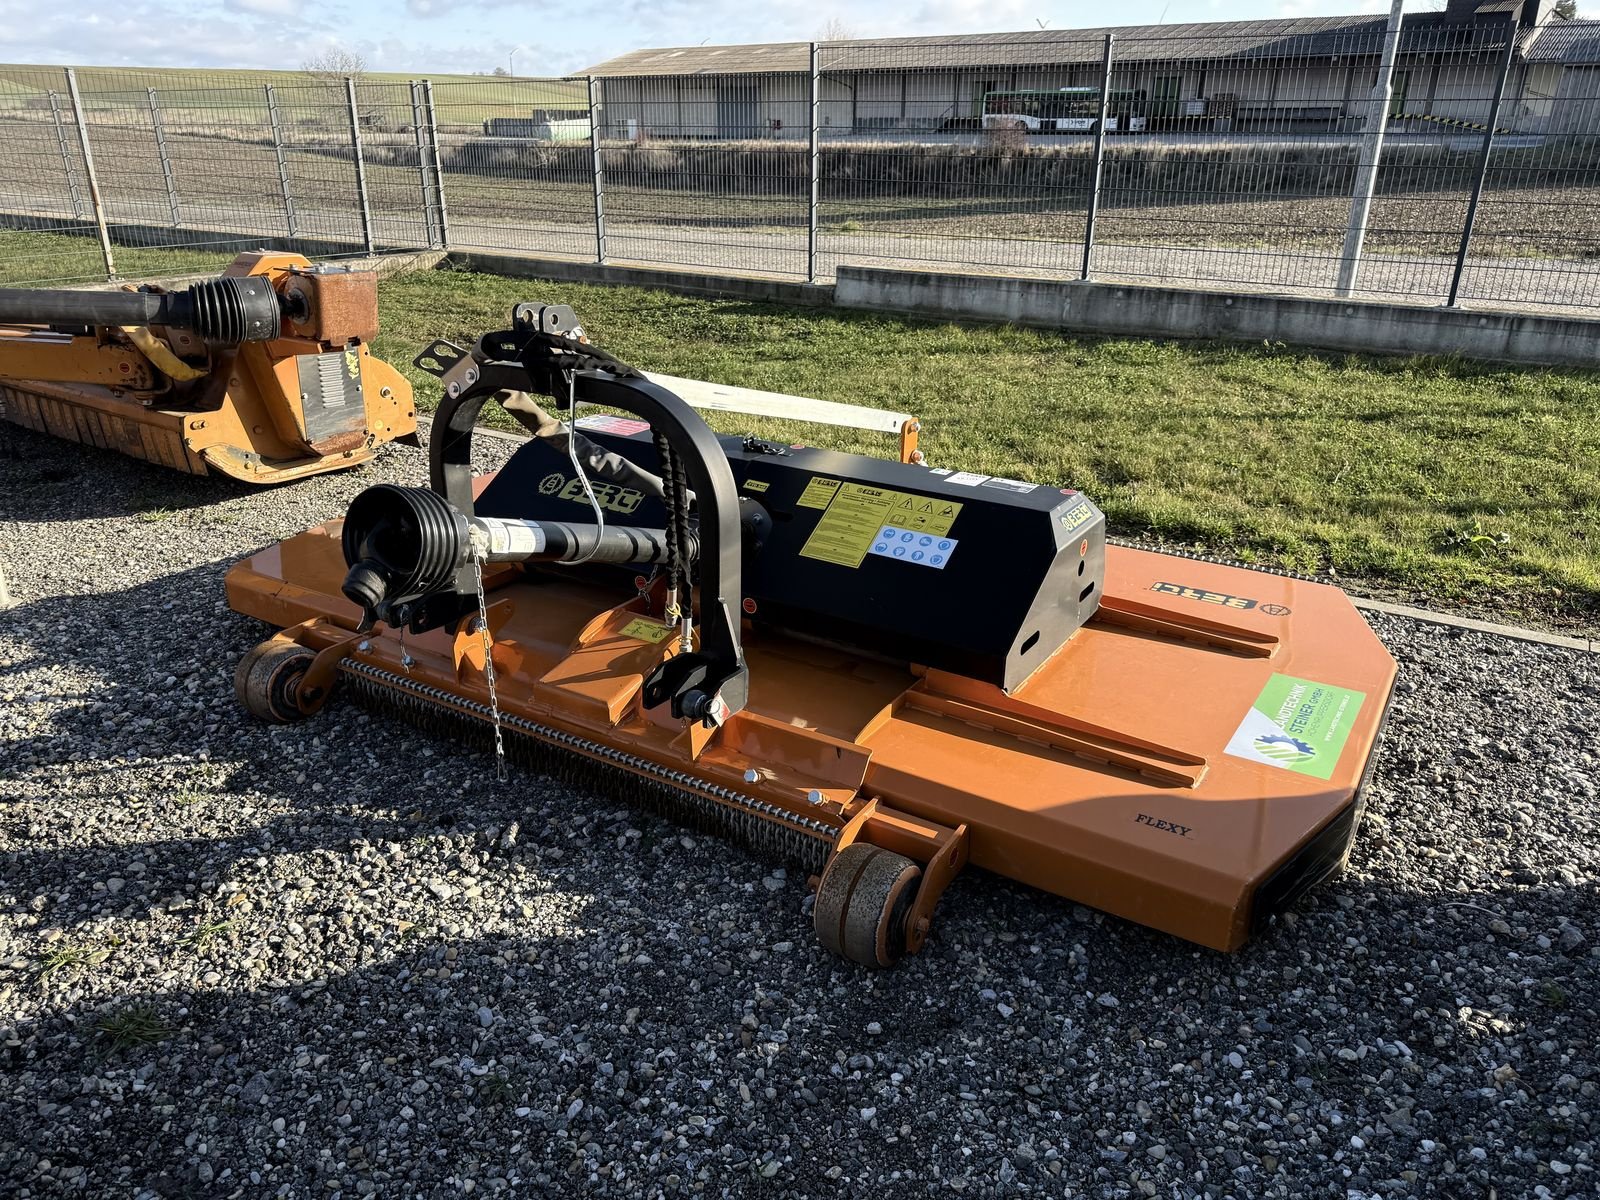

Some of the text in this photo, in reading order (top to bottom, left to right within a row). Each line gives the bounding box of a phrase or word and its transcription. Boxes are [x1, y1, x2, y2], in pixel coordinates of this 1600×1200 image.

[1275, 683, 1309, 730] LANDTECHNIK
[1289, 703, 1314, 734] STEINER
[1135, 813, 1193, 837] FLEXY
